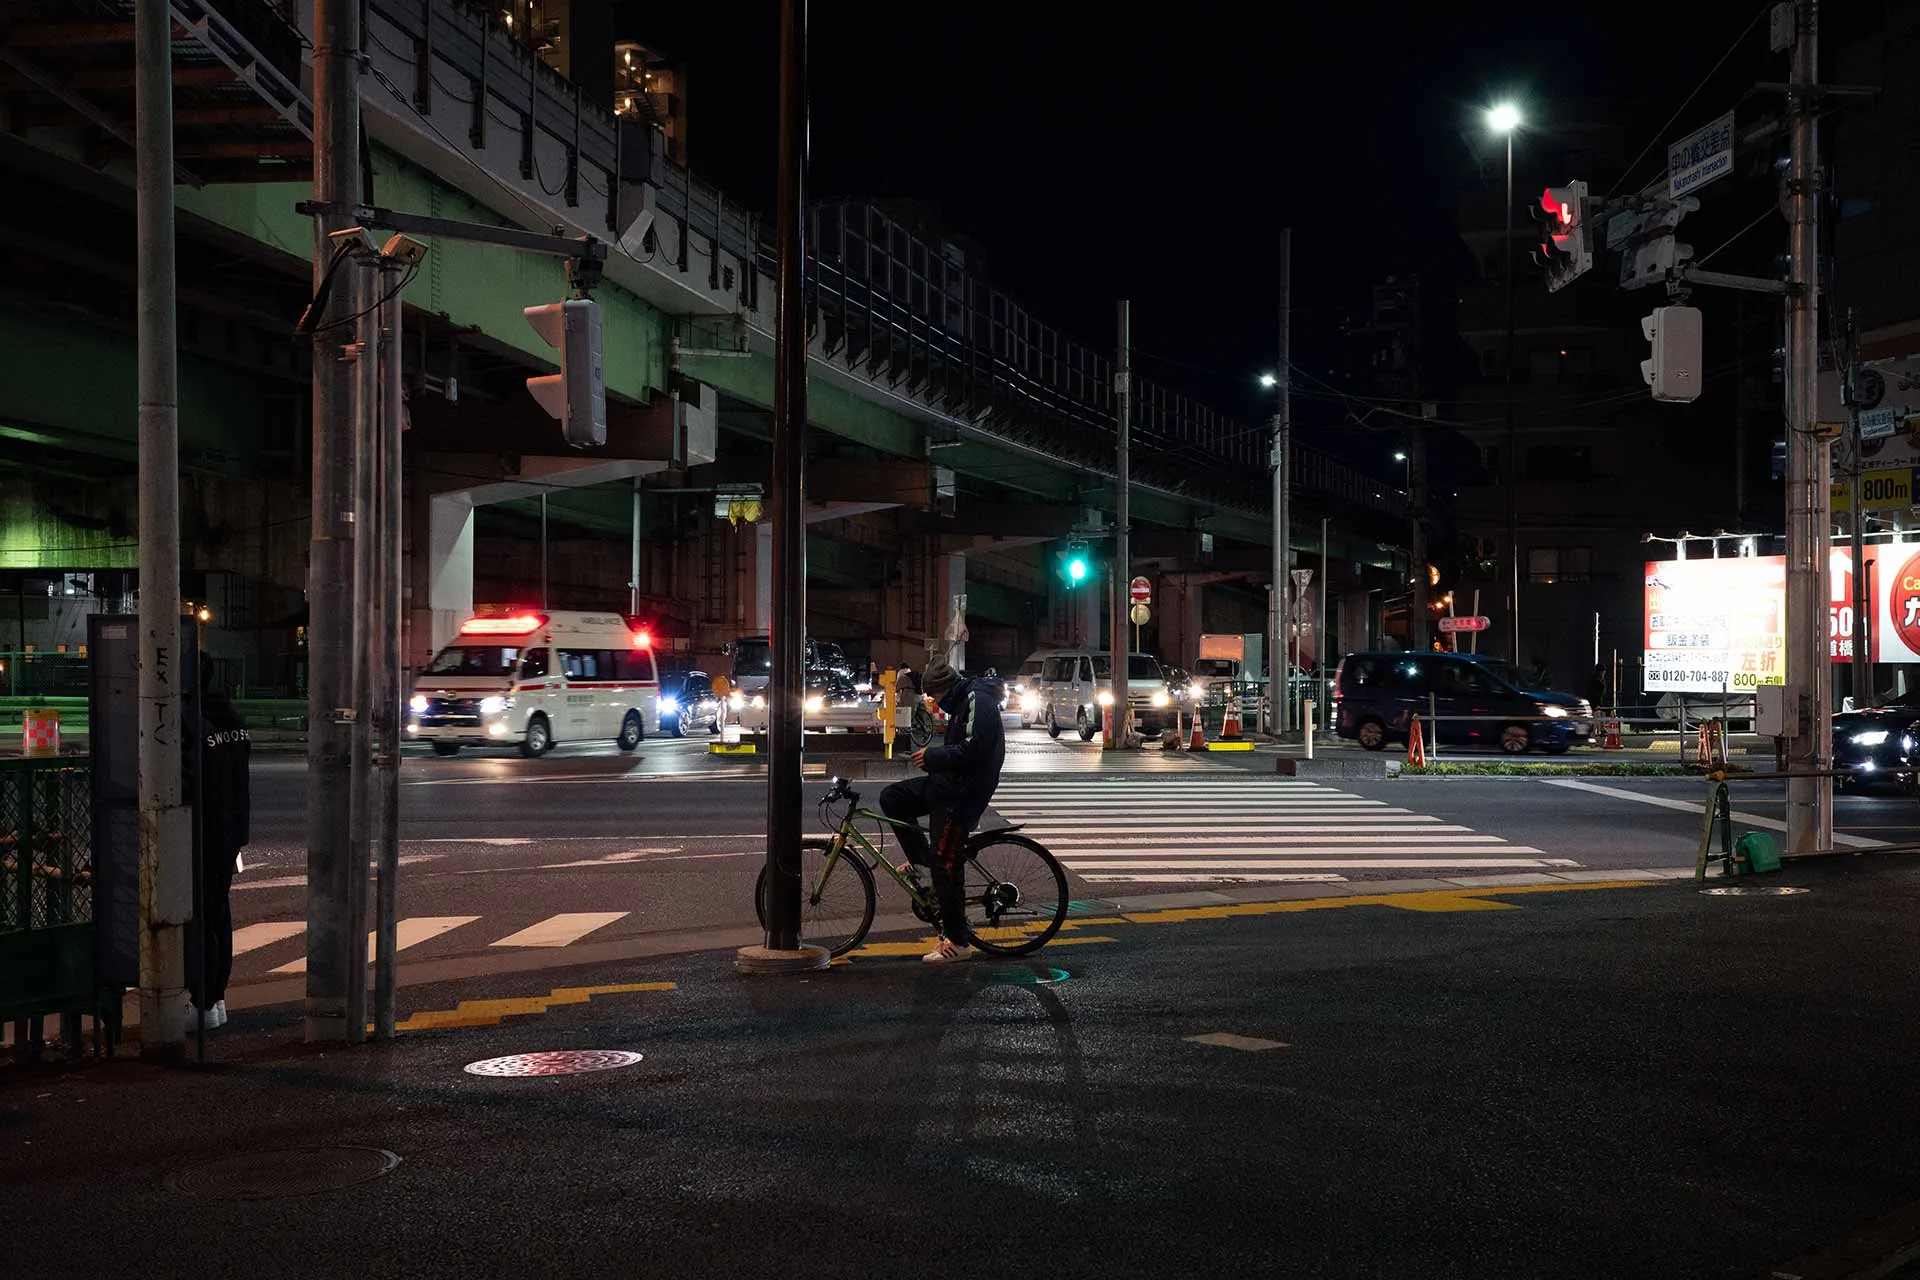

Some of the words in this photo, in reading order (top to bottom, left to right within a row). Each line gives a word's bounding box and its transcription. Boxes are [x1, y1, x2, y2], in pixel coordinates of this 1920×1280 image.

[1864, 477, 1909, 500] 800m
[1741, 650, 1777, 672] 左折
[1662, 670, 1729, 682] 0120-704-887
